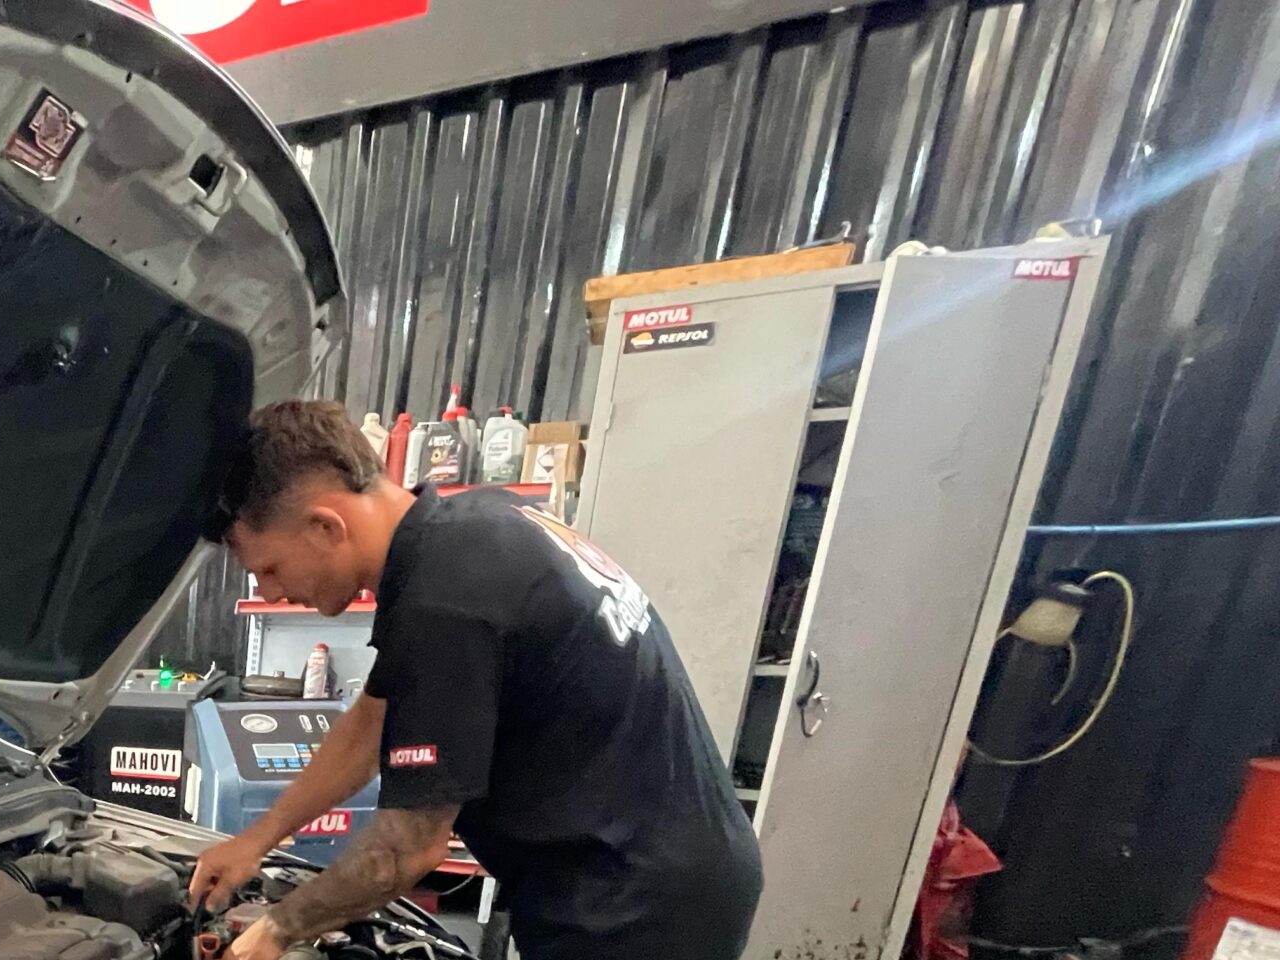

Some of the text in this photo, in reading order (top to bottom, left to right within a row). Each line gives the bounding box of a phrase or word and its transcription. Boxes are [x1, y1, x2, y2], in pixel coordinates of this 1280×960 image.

[1015, 260, 1071, 277] MOTUL
[628, 307, 690, 329] MOTUL
[658, 329, 709, 345] REPSOL
[115, 750, 177, 773] MAHOVI
[111, 781, 176, 798] MAH-2002
[300, 813, 348, 832] TUL
